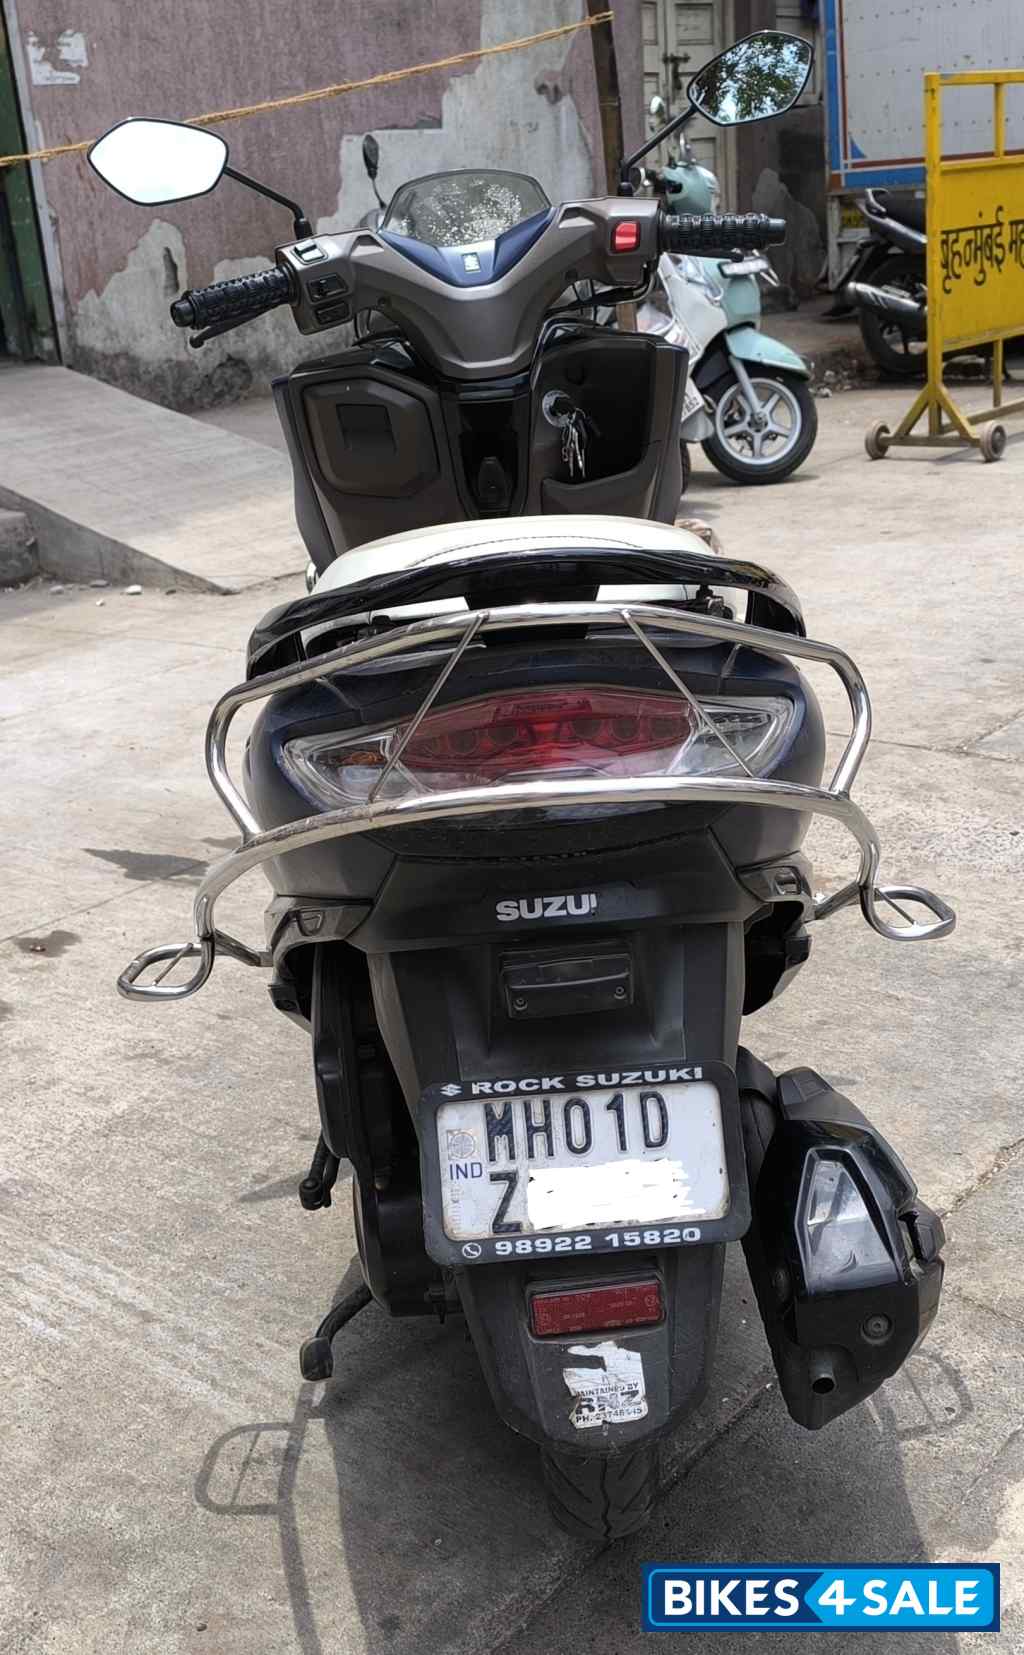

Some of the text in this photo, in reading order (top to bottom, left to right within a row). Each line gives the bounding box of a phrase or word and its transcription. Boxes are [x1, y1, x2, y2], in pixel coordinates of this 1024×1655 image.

[471, 1067, 703, 1095] ROCK SUZUKI
[449, 1162, 483, 1180] IND
[495, 1227, 701, 1256] 98922 15820
